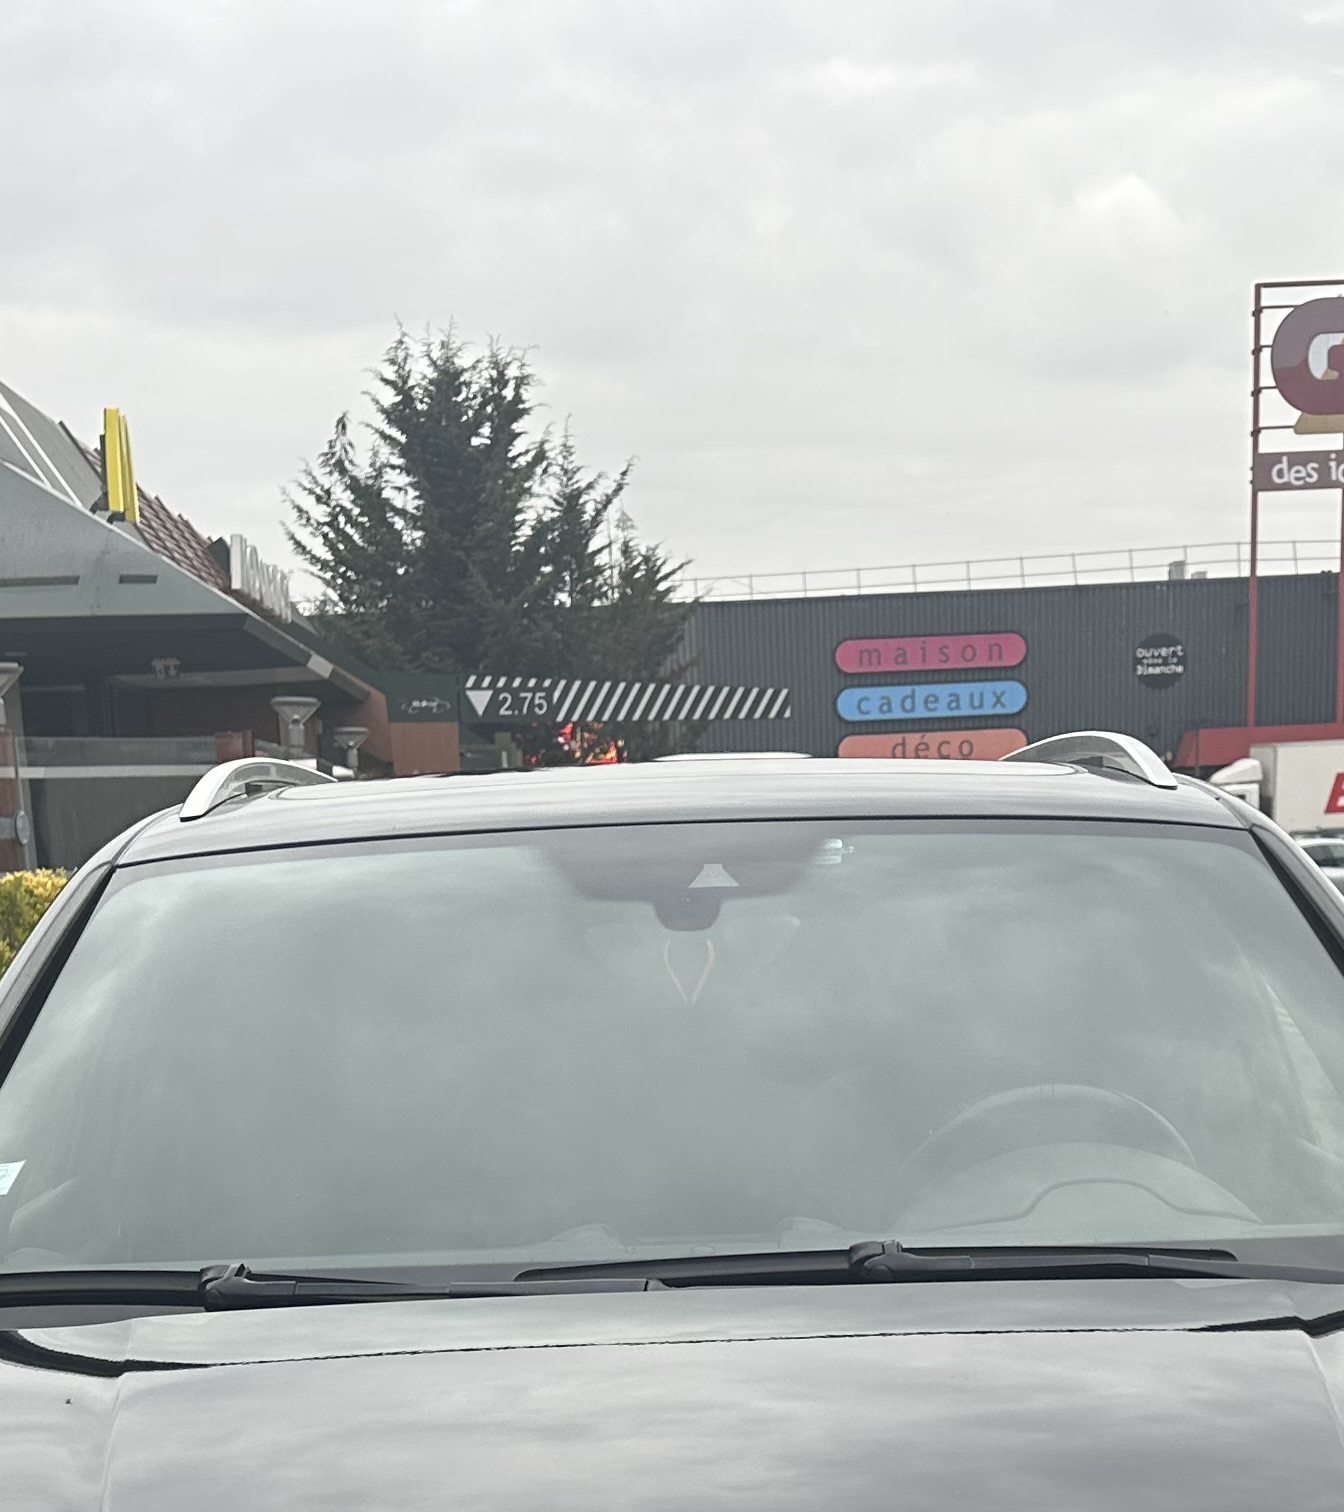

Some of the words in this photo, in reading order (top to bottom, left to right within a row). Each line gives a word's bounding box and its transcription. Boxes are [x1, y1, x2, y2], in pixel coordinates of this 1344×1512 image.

[1271, 456, 1319, 485] des
[858, 641, 1004, 668] maison
[1136, 644, 1184, 658] ouvert
[498, 691, 548, 716] 2.75
[856, 688, 1007, 716] cadeaux
[892, 734, 975, 759] déco
